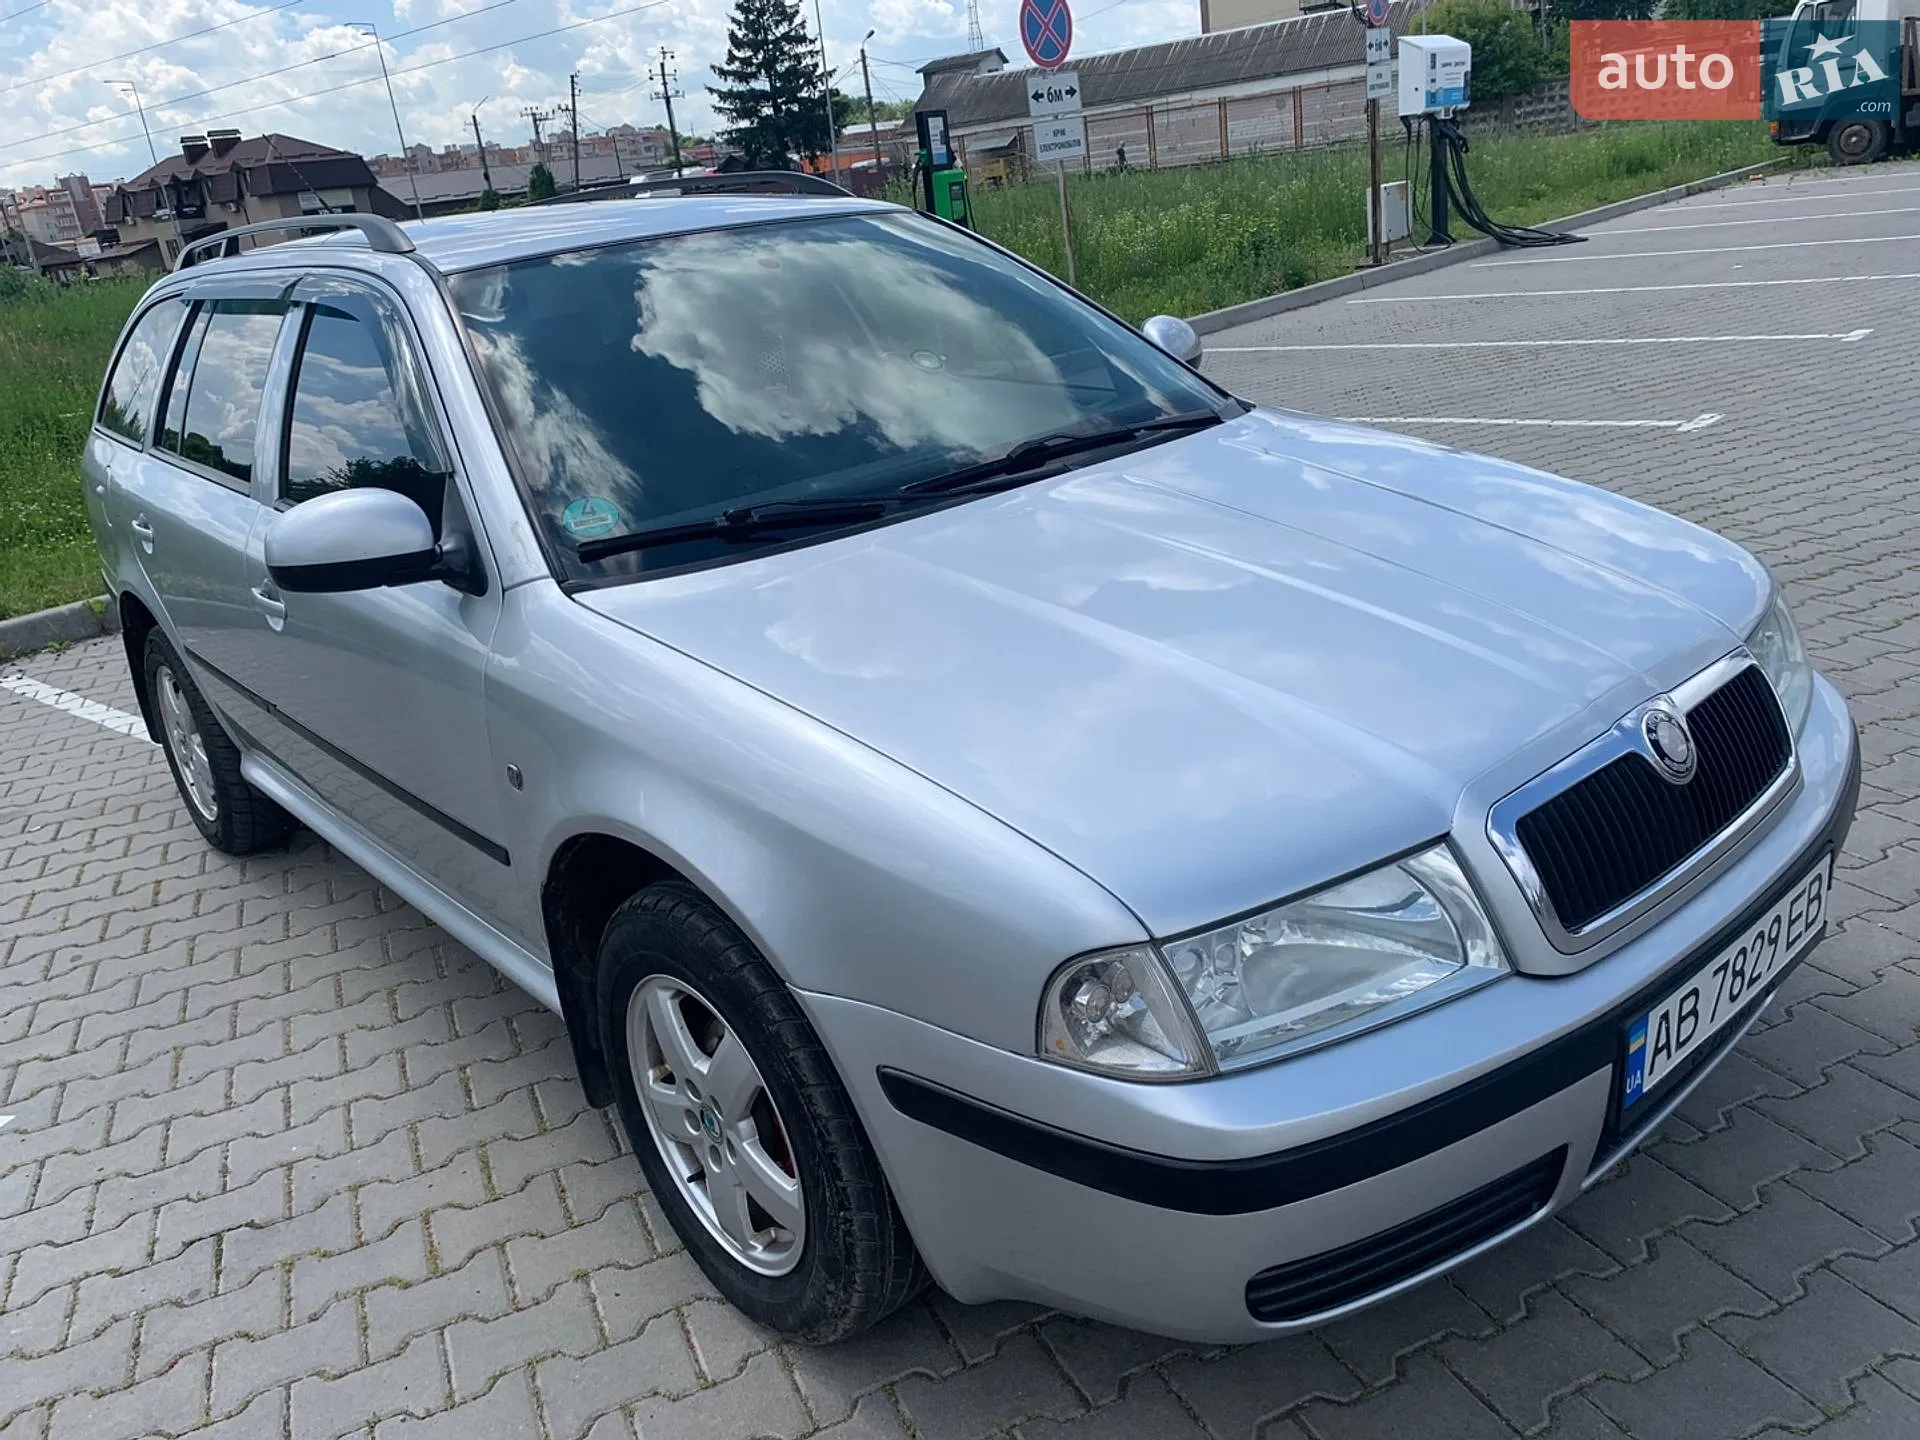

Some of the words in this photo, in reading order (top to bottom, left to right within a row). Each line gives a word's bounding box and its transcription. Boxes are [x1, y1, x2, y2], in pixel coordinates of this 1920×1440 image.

[1648, 986, 1700, 1077] AB
[1709, 913, 1782, 1025] 7829
[1785, 872, 1823, 952] EB
[1626, 1069, 1642, 1094] UA
